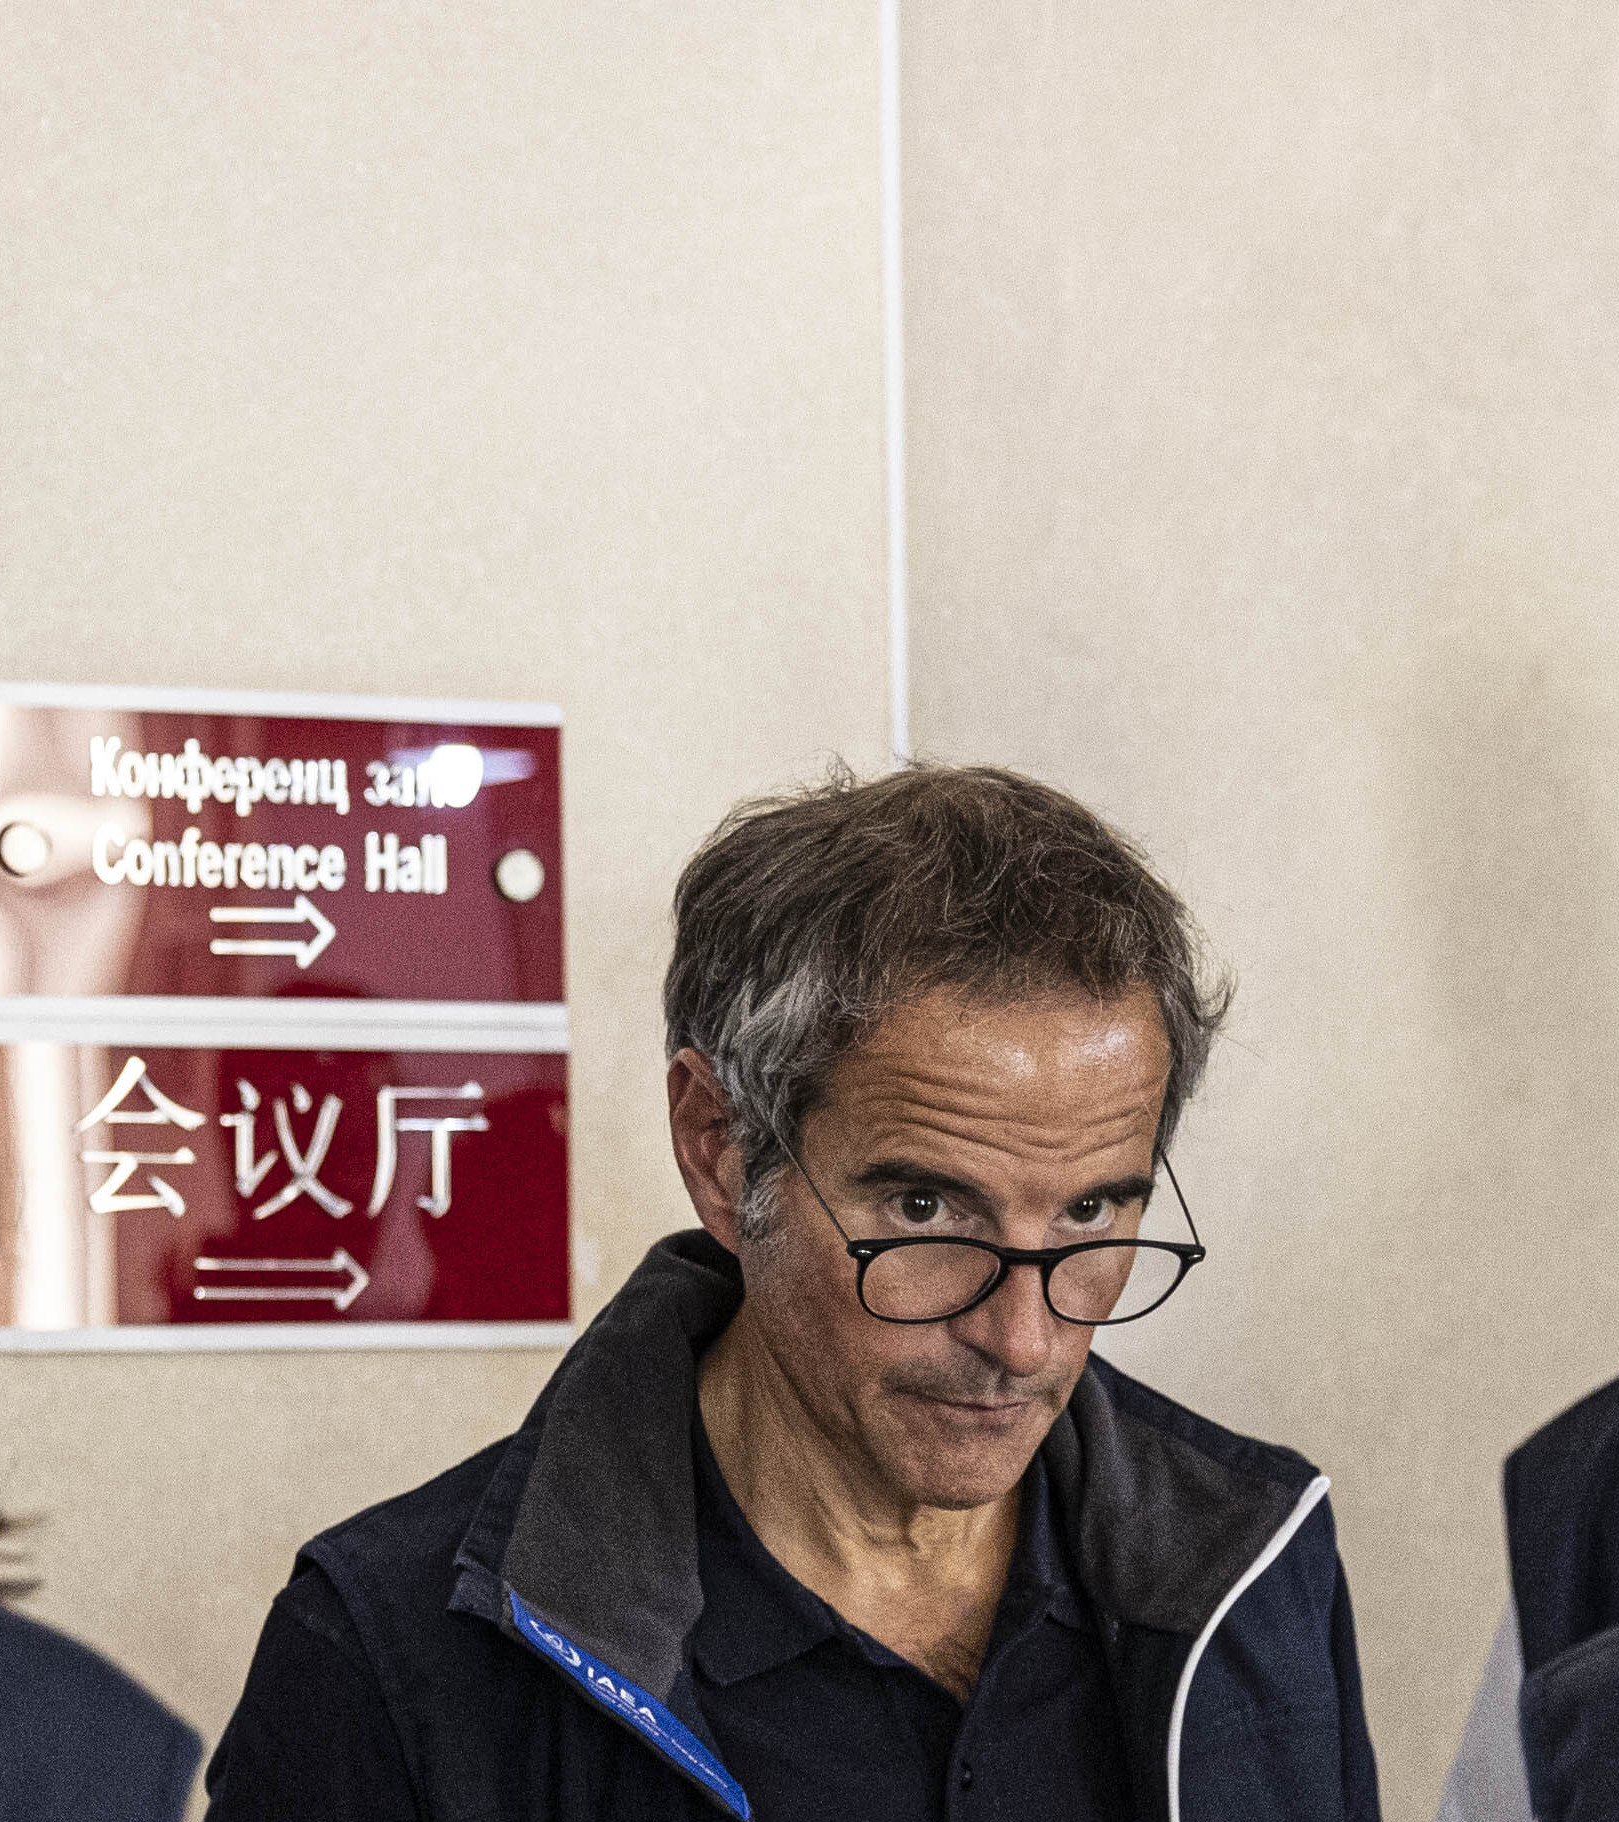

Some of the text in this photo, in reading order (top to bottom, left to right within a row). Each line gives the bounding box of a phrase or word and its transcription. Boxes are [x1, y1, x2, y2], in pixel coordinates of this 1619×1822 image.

[89, 735, 351, 817] Конференц
[91, 824, 447, 894] Conference Hall
[78, 1055, 490, 1218] 会议厅
[586, 1665, 657, 1725] IAEA
